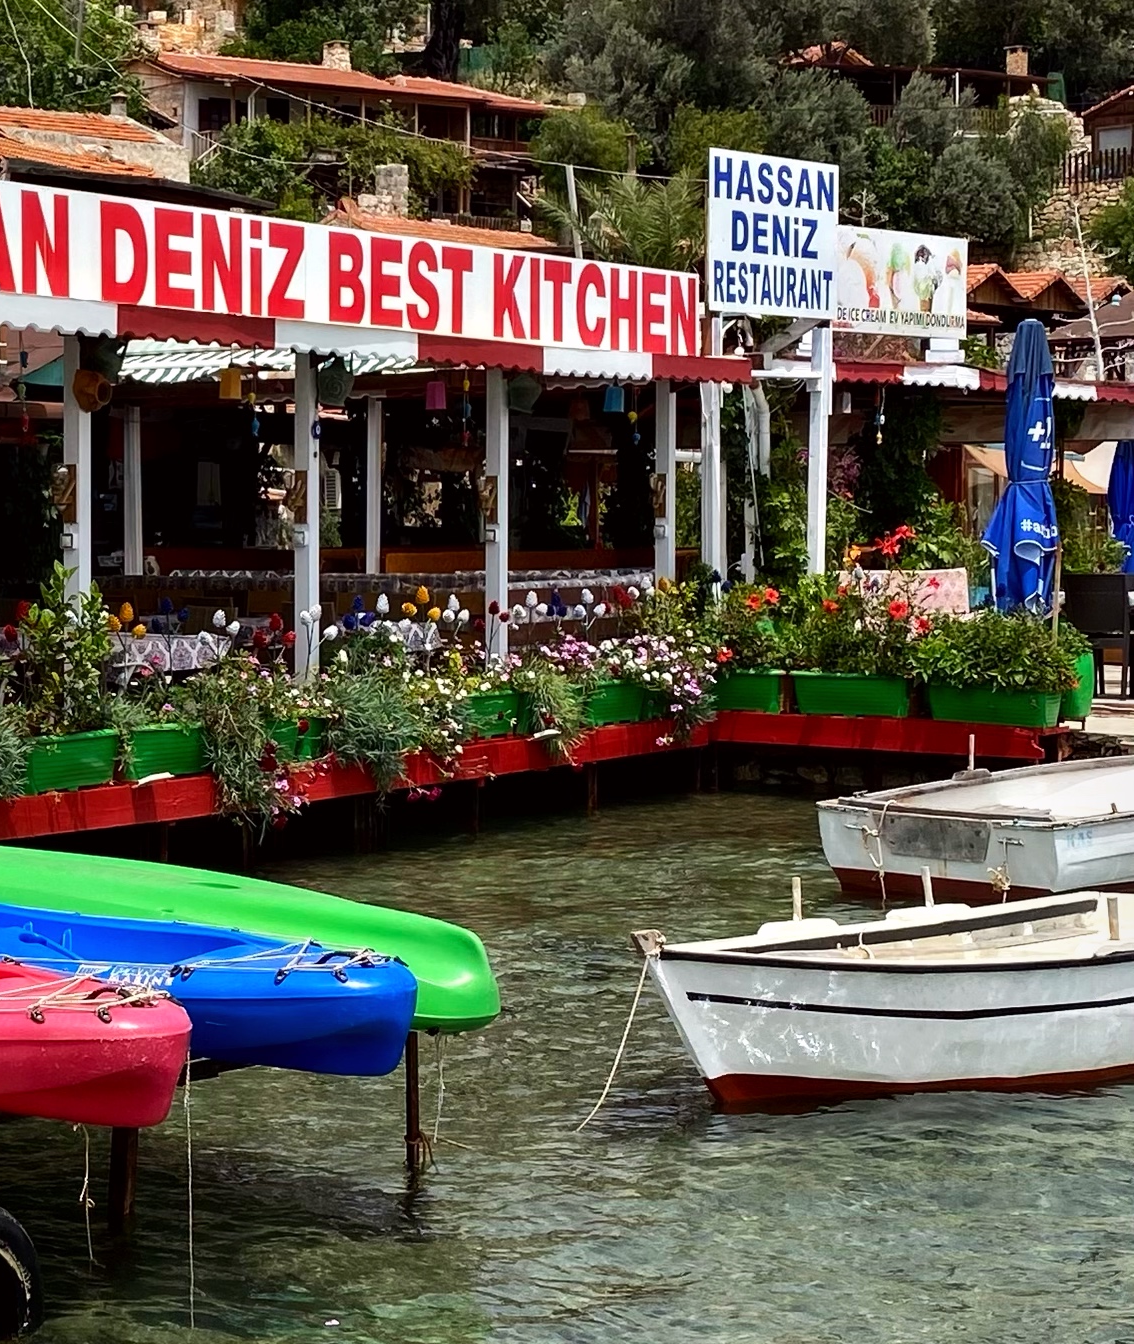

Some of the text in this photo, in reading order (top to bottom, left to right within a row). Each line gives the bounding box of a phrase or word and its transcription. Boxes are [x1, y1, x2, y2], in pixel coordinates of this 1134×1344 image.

[714, 156, 834, 212] HASSAN
[328, 231, 473, 334] BEST
[493, 253, 696, 356] KITCHEN
[714, 260, 833, 311] RESTAURANT
[848, 308, 860, 322] ICE
[861, 309, 887, 323] CREAM
[889, 311, 899, 324] EV
